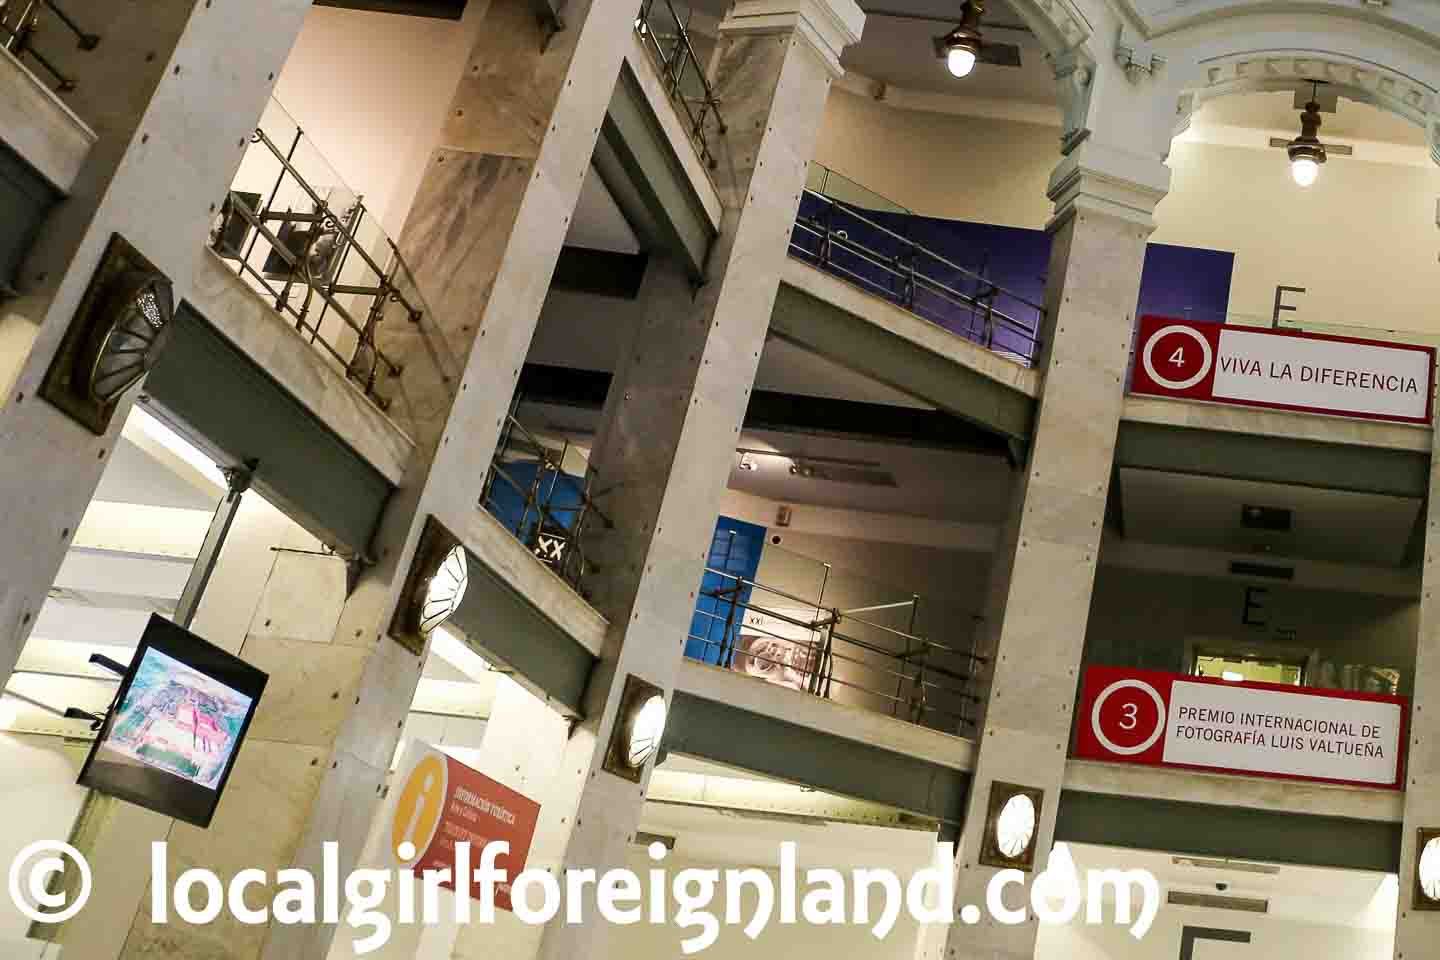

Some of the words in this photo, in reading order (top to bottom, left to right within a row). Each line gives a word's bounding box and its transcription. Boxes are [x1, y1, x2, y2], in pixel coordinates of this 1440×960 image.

[1167, 346, 1186, 369] 4
[1219, 356, 1262, 377] VIVA
[1269, 361, 1293, 380] LA
[1300, 365, 1419, 394] DIFERENCIA
[1117, 702, 1139, 731] 3
[1178, 706, 1236, 725] PREMIO
[1239, 711, 1358, 739] INTERNACIONAL
[1361, 724, 1382, 740] DE
[1175, 725, 1266, 747] FOTOGRAFÍA
[1270, 734, 1305, 751] LUIS
[1309, 738, 1385, 760] VALTUEÑA
